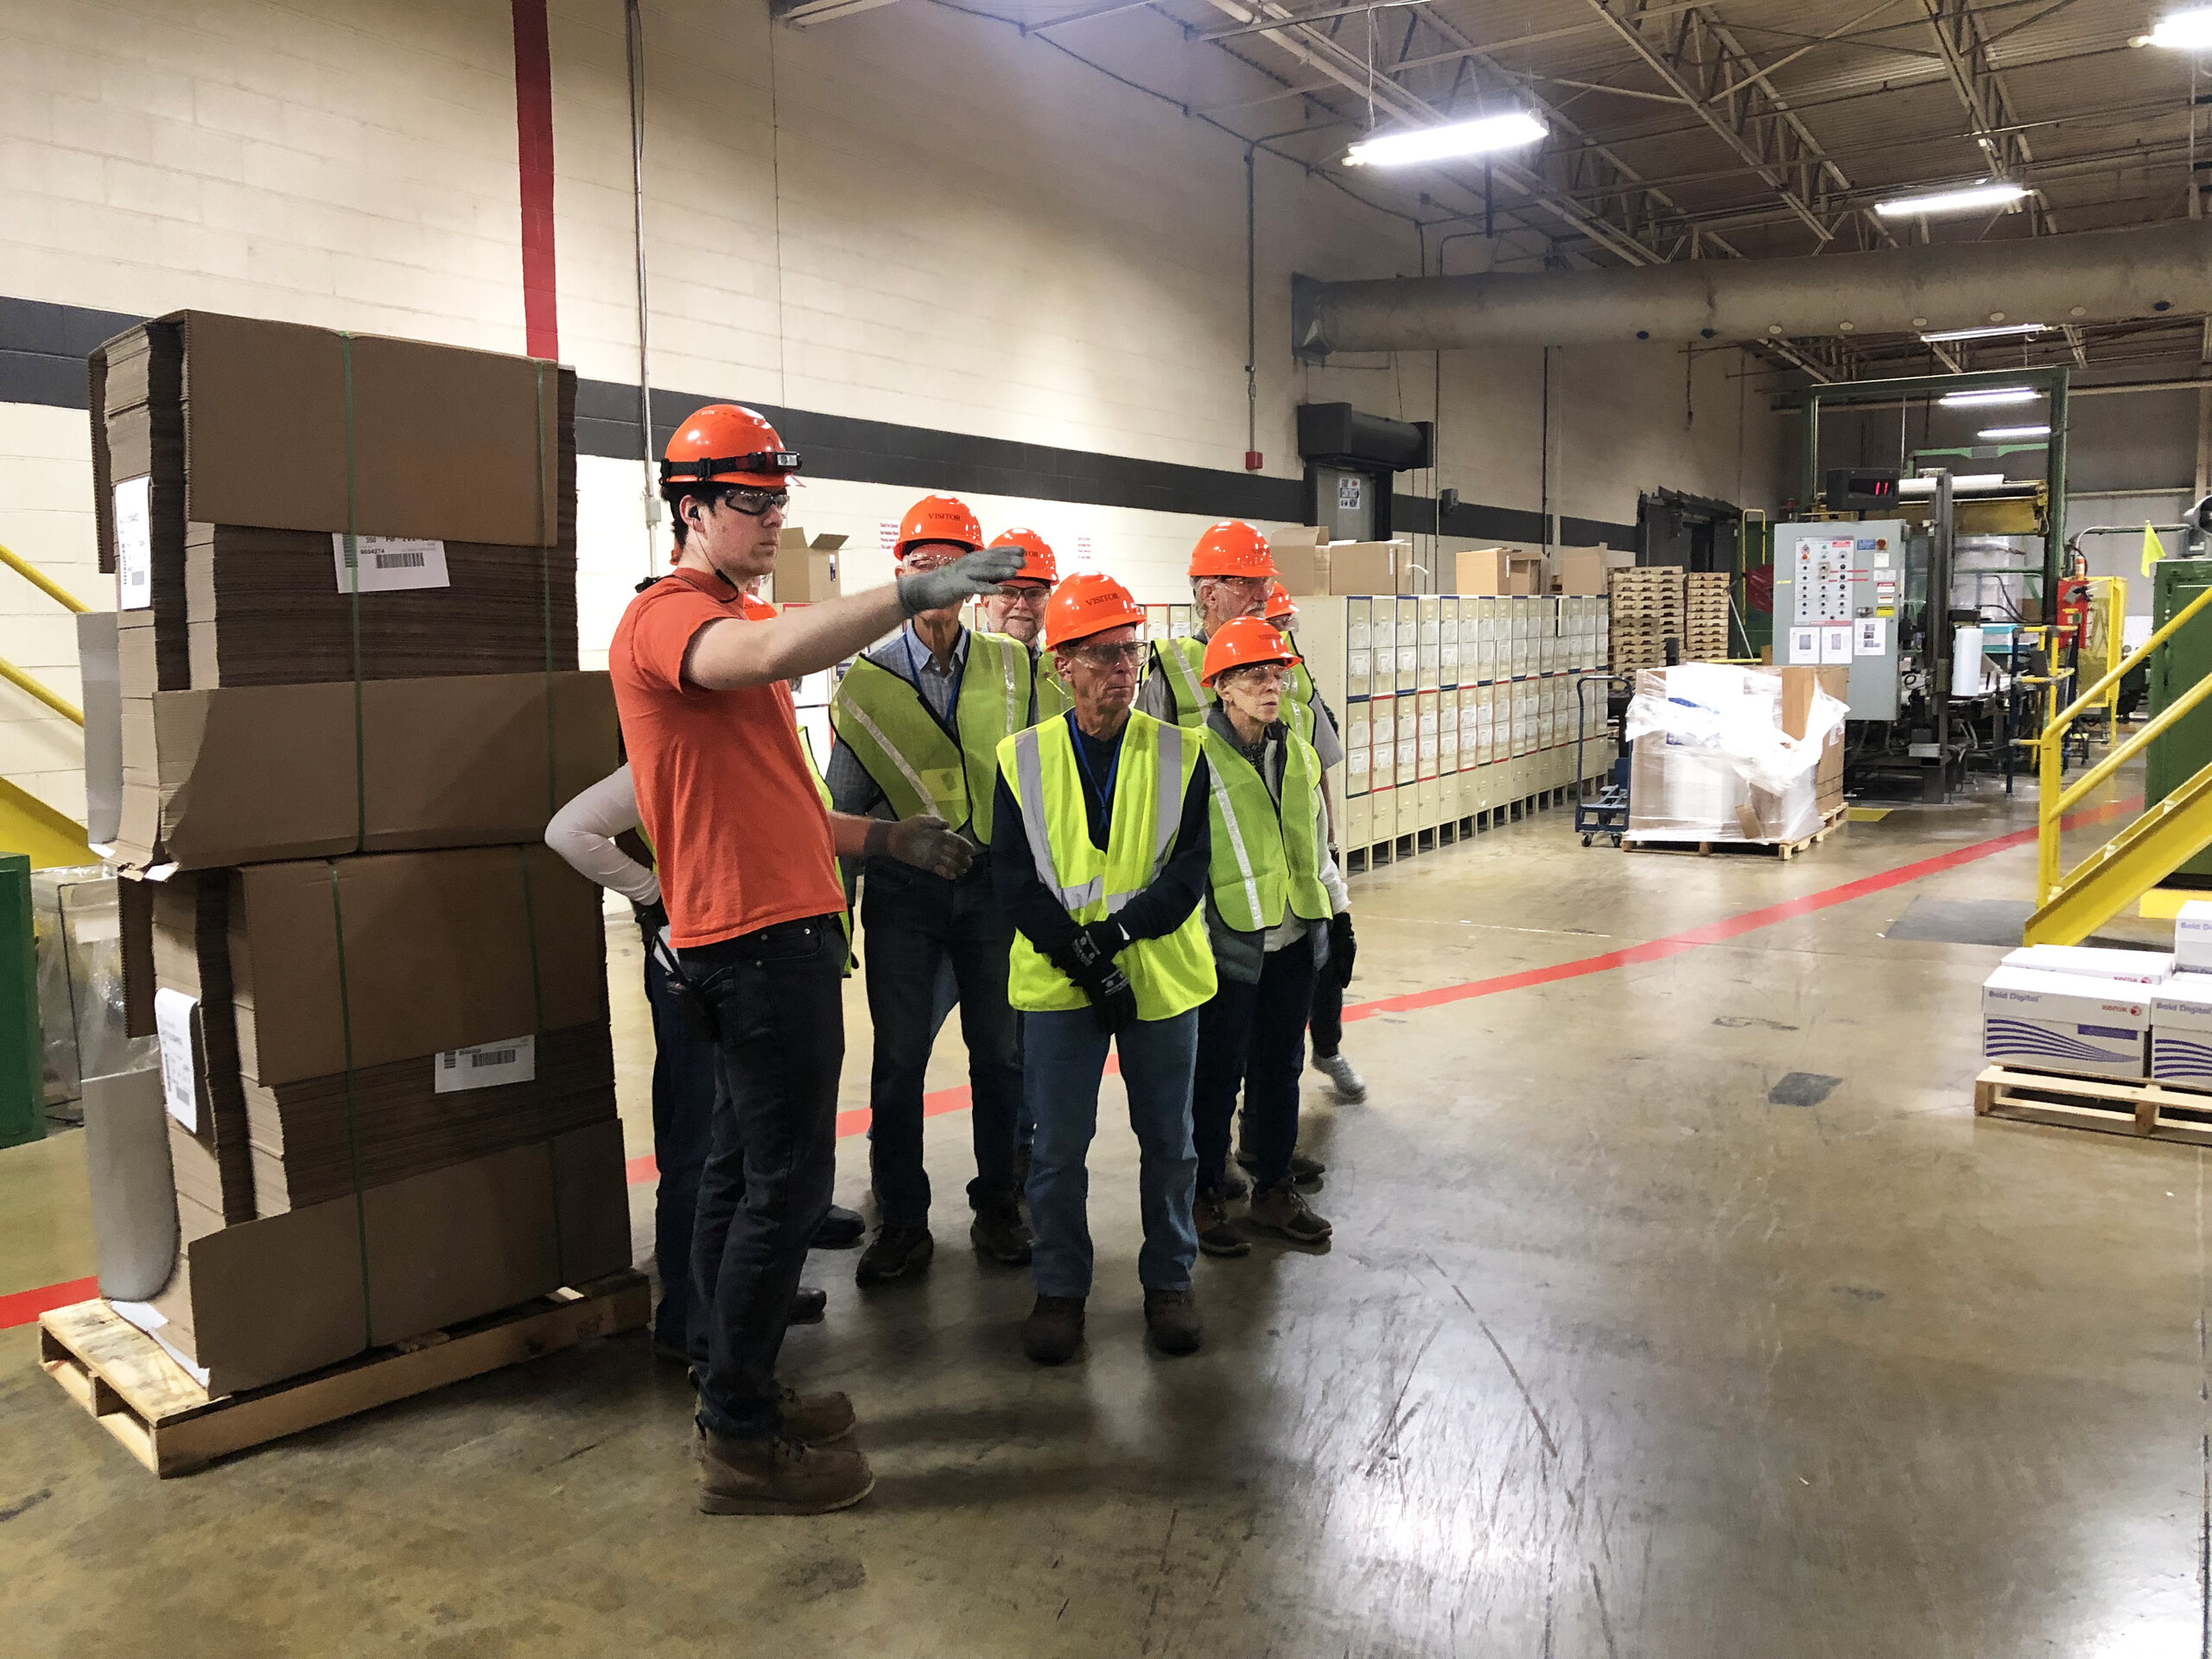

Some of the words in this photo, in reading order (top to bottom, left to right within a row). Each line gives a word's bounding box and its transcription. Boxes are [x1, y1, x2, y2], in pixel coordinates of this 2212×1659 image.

[1875, 481, 1889, 495] 11
[928, 512, 961, 521] VISITOR
[1085, 592, 1119, 606] VISITOR
[1989, 990, 2007, 999] Bold
[2009, 993, 2039, 1003] Digital
[2156, 1002, 2177, 1011] Bold
[2179, 1004, 2212, 1014] Digital
